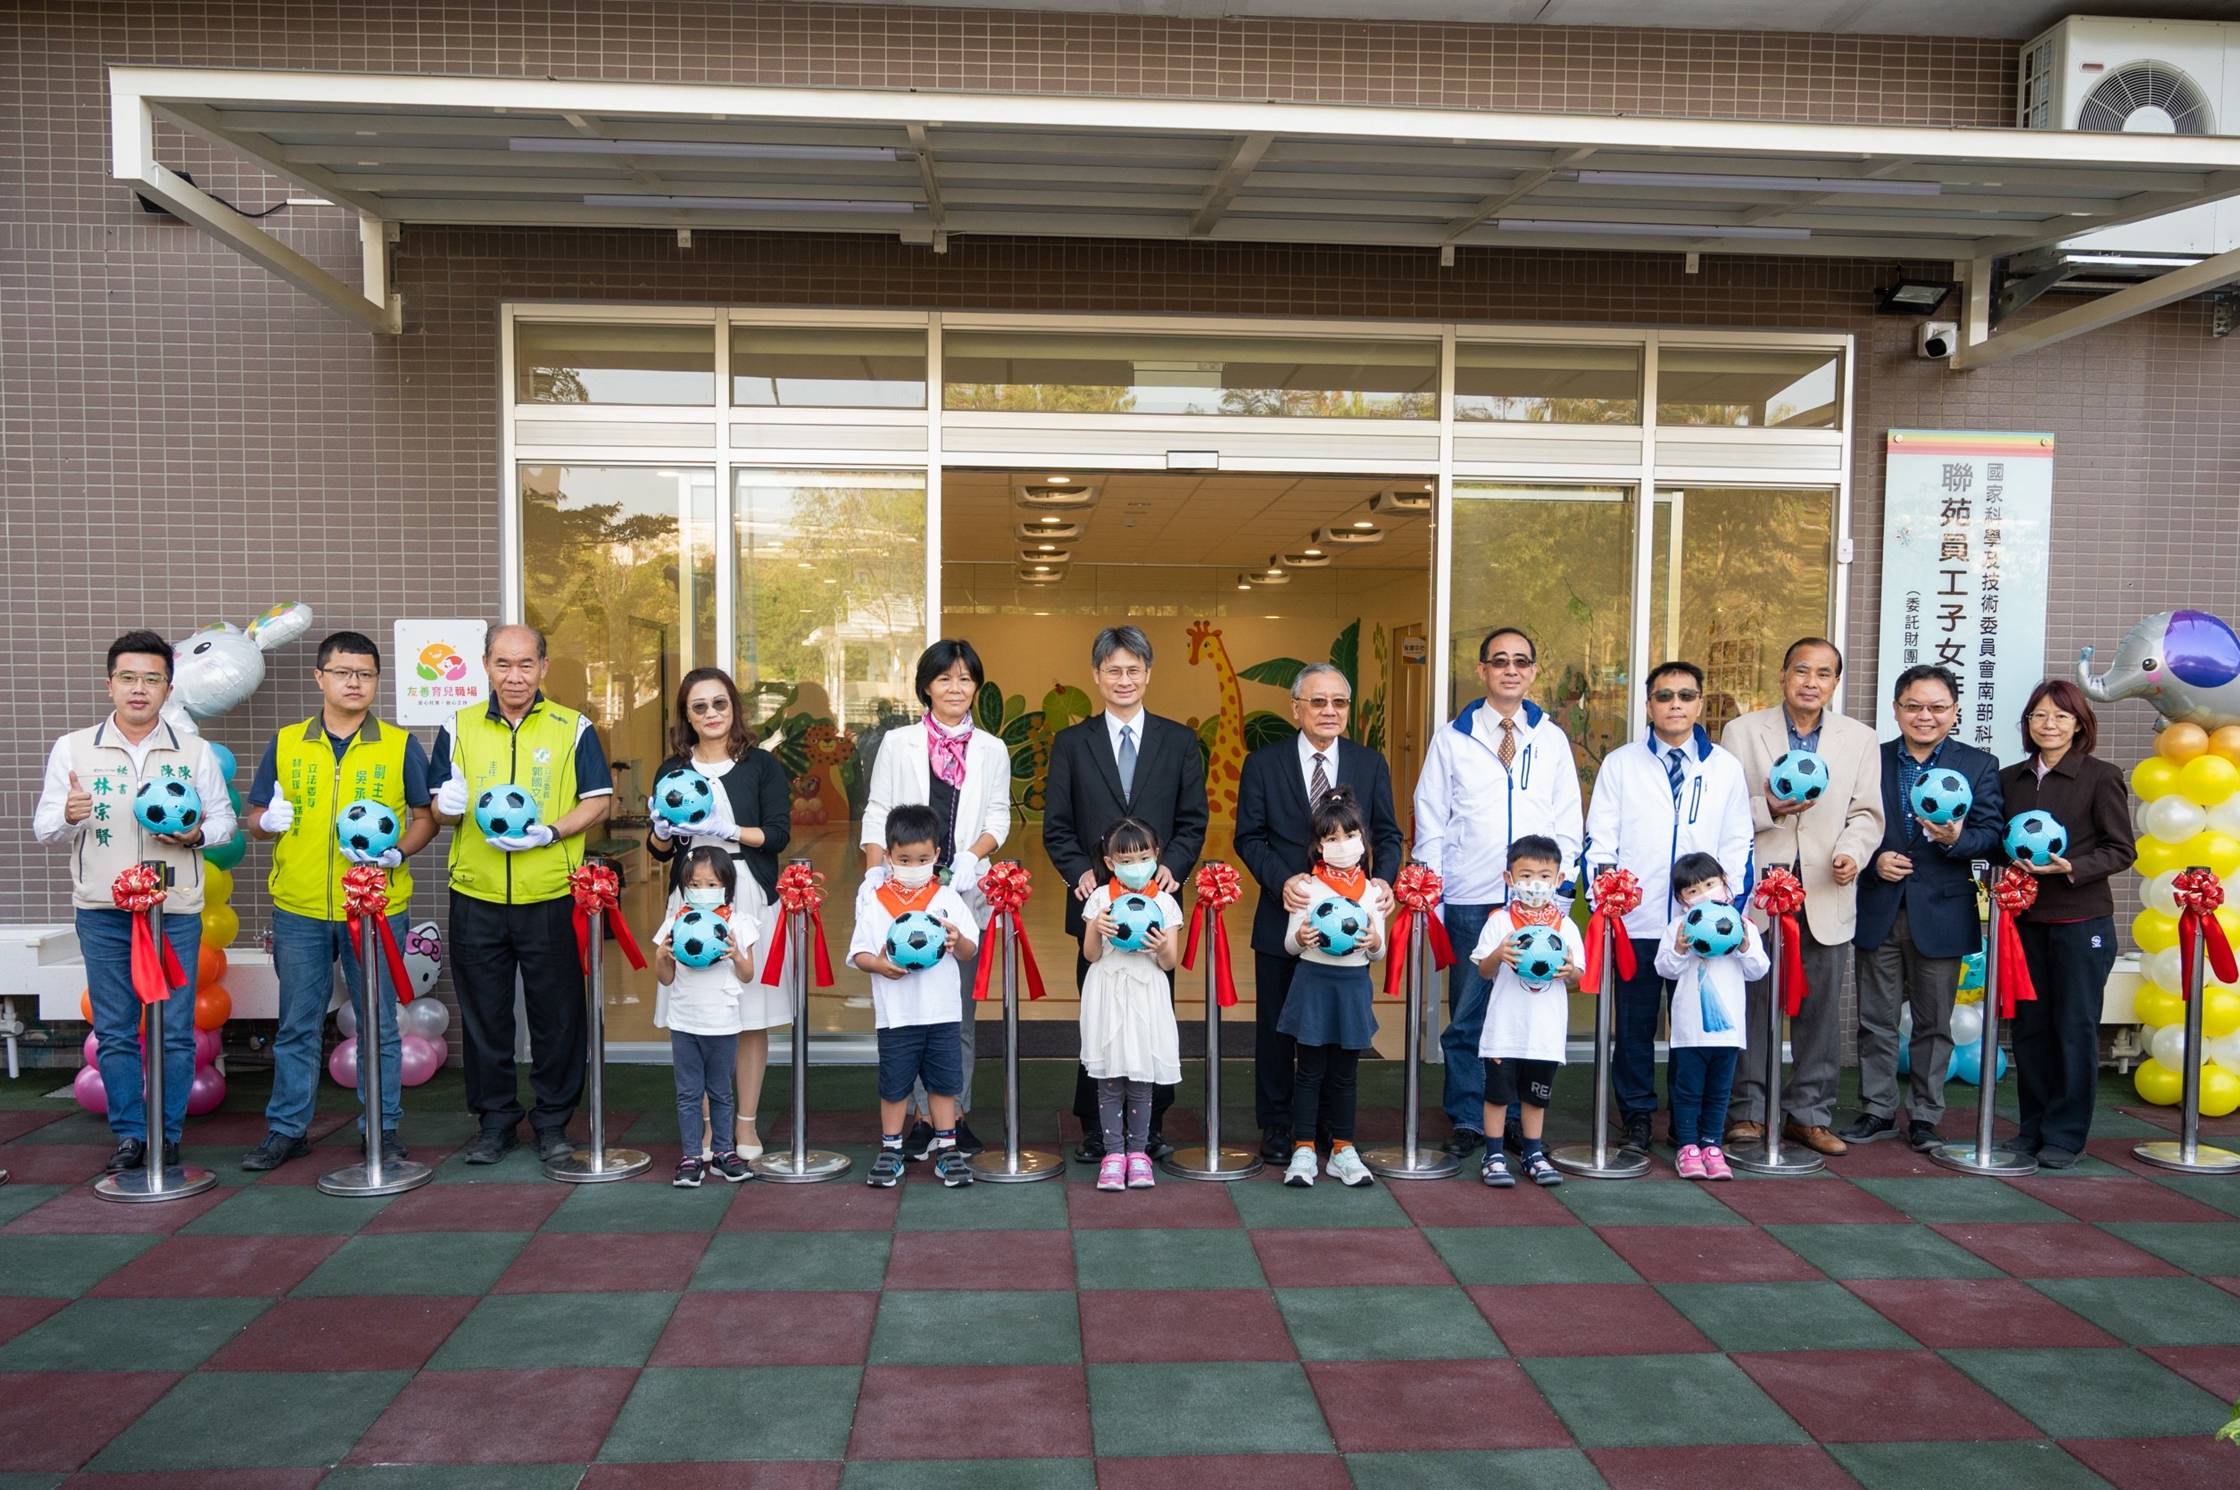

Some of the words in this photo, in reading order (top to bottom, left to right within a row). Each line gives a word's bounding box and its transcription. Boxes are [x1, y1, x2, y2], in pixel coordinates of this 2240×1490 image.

[1904, 590, 1920, 670] (委託財團
[407, 686, 478, 697] 友善育兒職場
[93, 776, 113, 848] 林宗賢
[1531, 1081, 1552, 1097] RE
